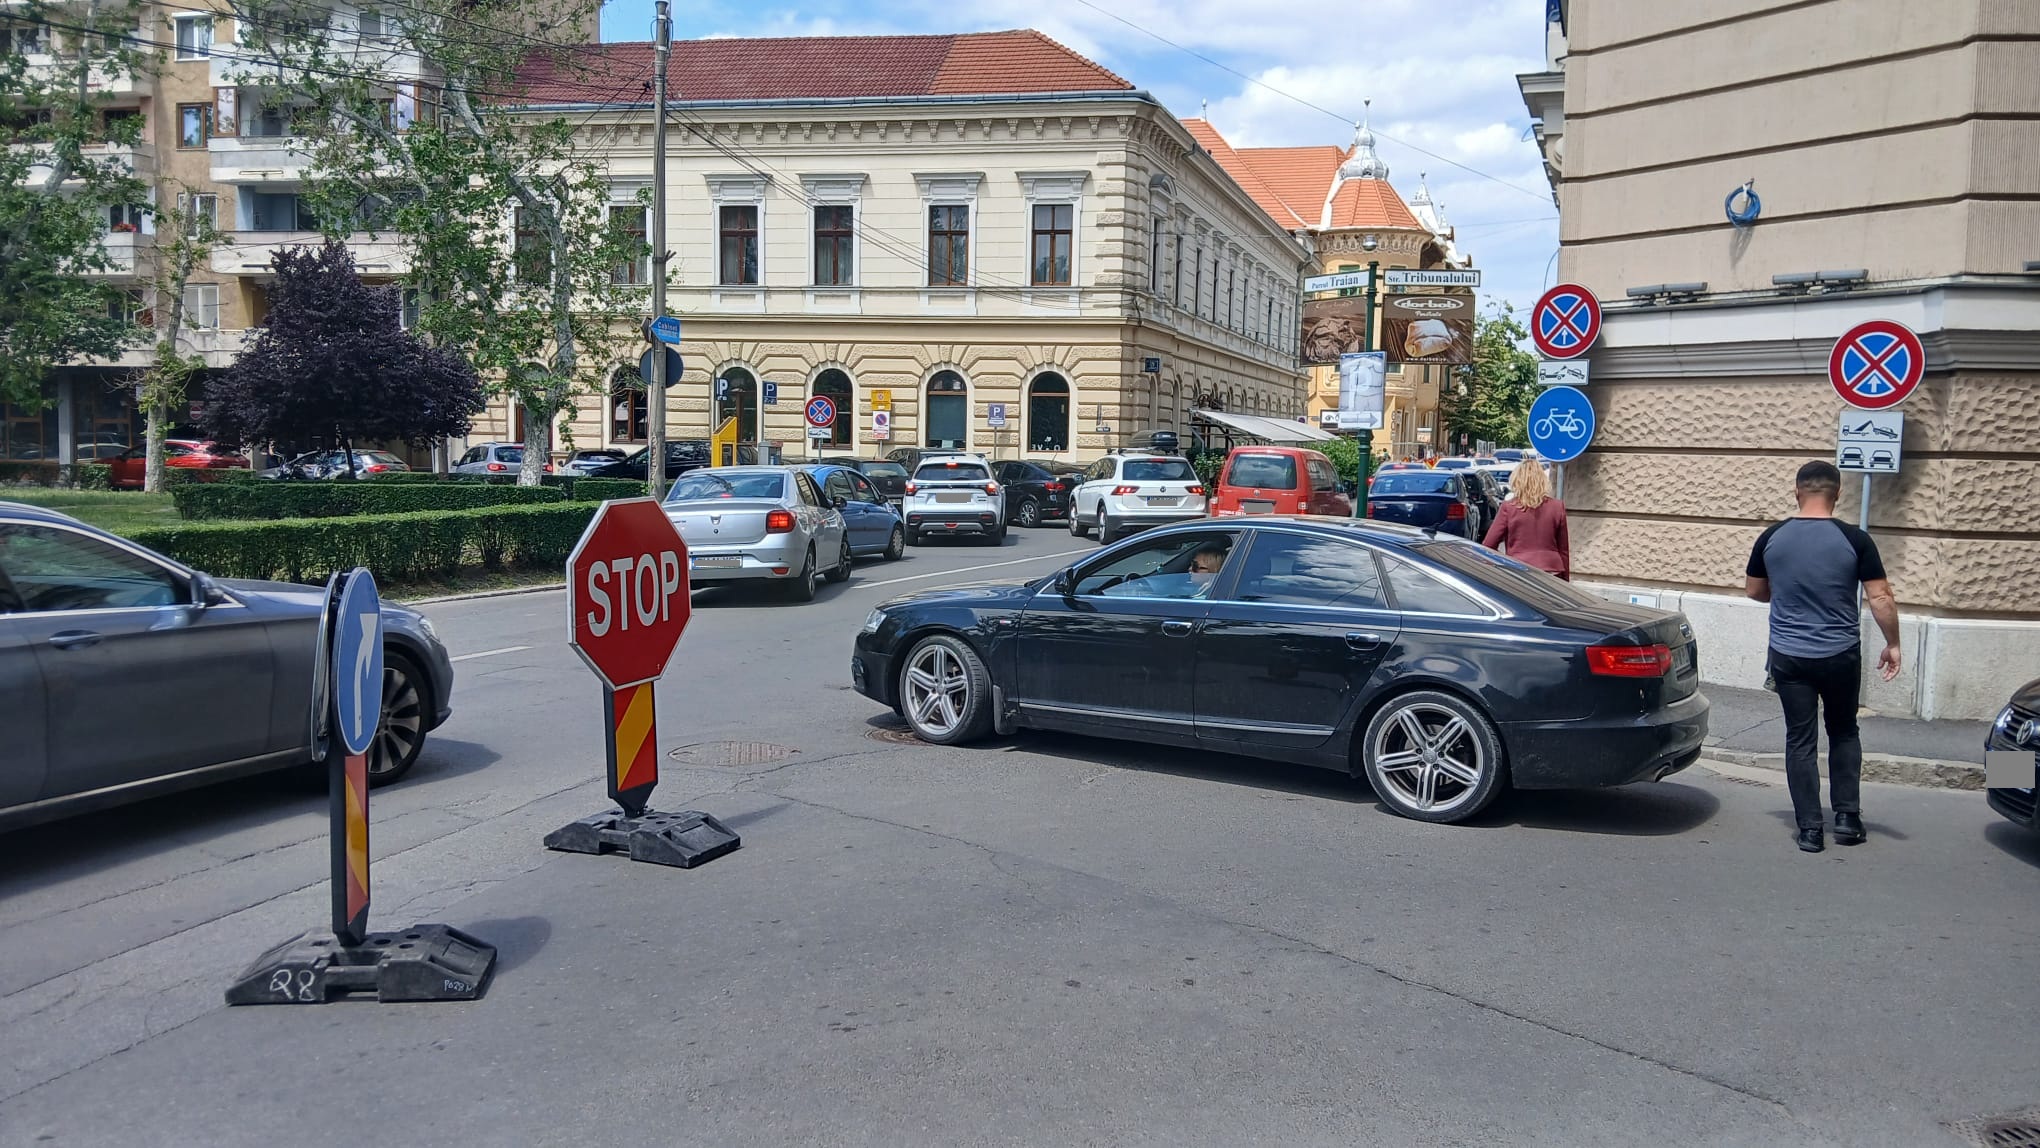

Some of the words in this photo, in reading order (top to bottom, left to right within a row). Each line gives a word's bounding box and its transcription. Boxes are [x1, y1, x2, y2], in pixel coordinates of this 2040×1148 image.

[1330, 275, 1359, 288] Traian
[1402, 272, 1476, 283] Tribunalului
[766, 383, 775, 396] P
[993, 406, 1001, 417] P
[587, 551, 680, 637] STOP
